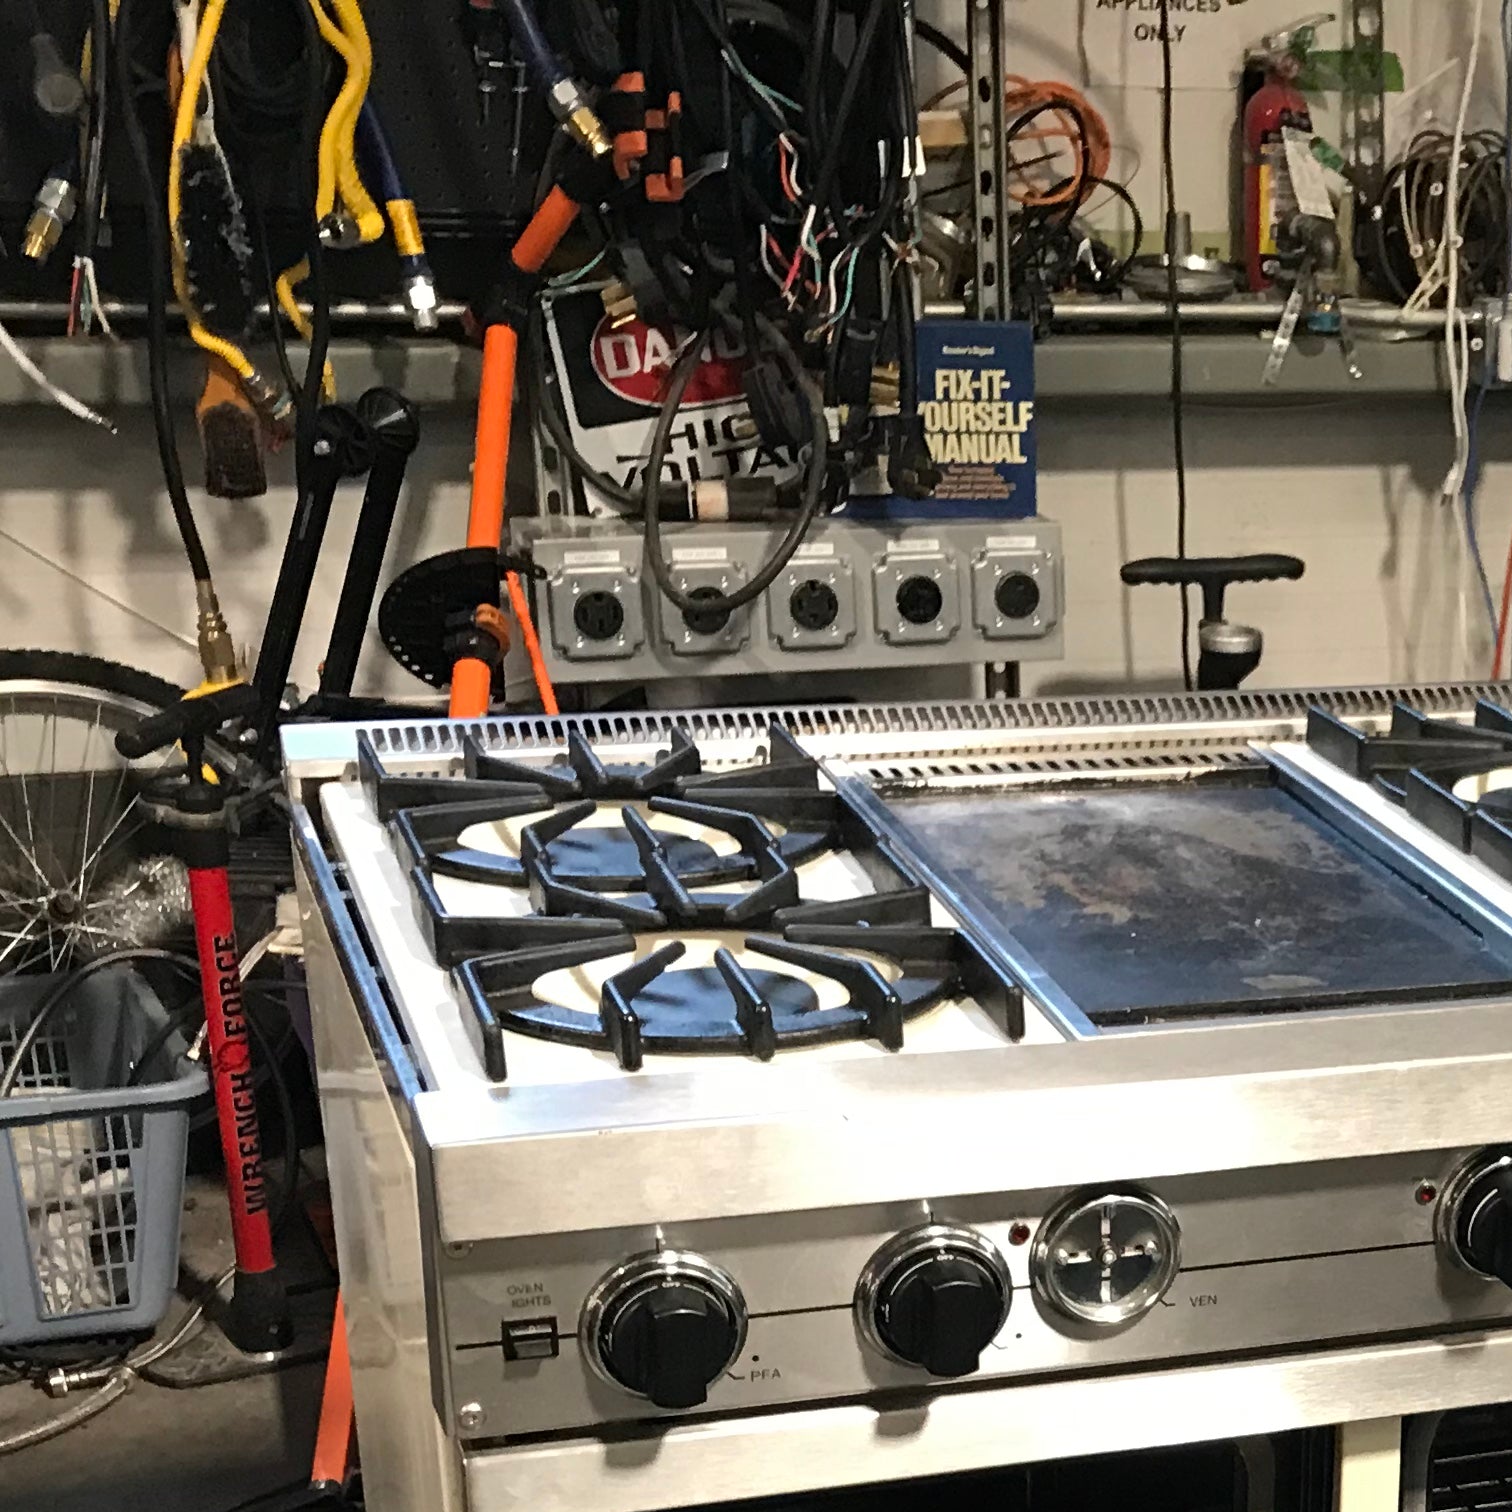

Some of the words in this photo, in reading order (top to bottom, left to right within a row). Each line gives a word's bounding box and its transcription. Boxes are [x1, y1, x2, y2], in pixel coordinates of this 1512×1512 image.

[935, 368, 1011, 401] FIX-IT-
[667, 412, 762, 454] HIG
[924, 432, 1028, 464] MANUAL
[214, 934, 248, 1039] FORCE
[231, 1072, 266, 1215] WRENCH
[507, 1282, 544, 1296] OVEN
[511, 1294, 552, 1309] IGHTS
